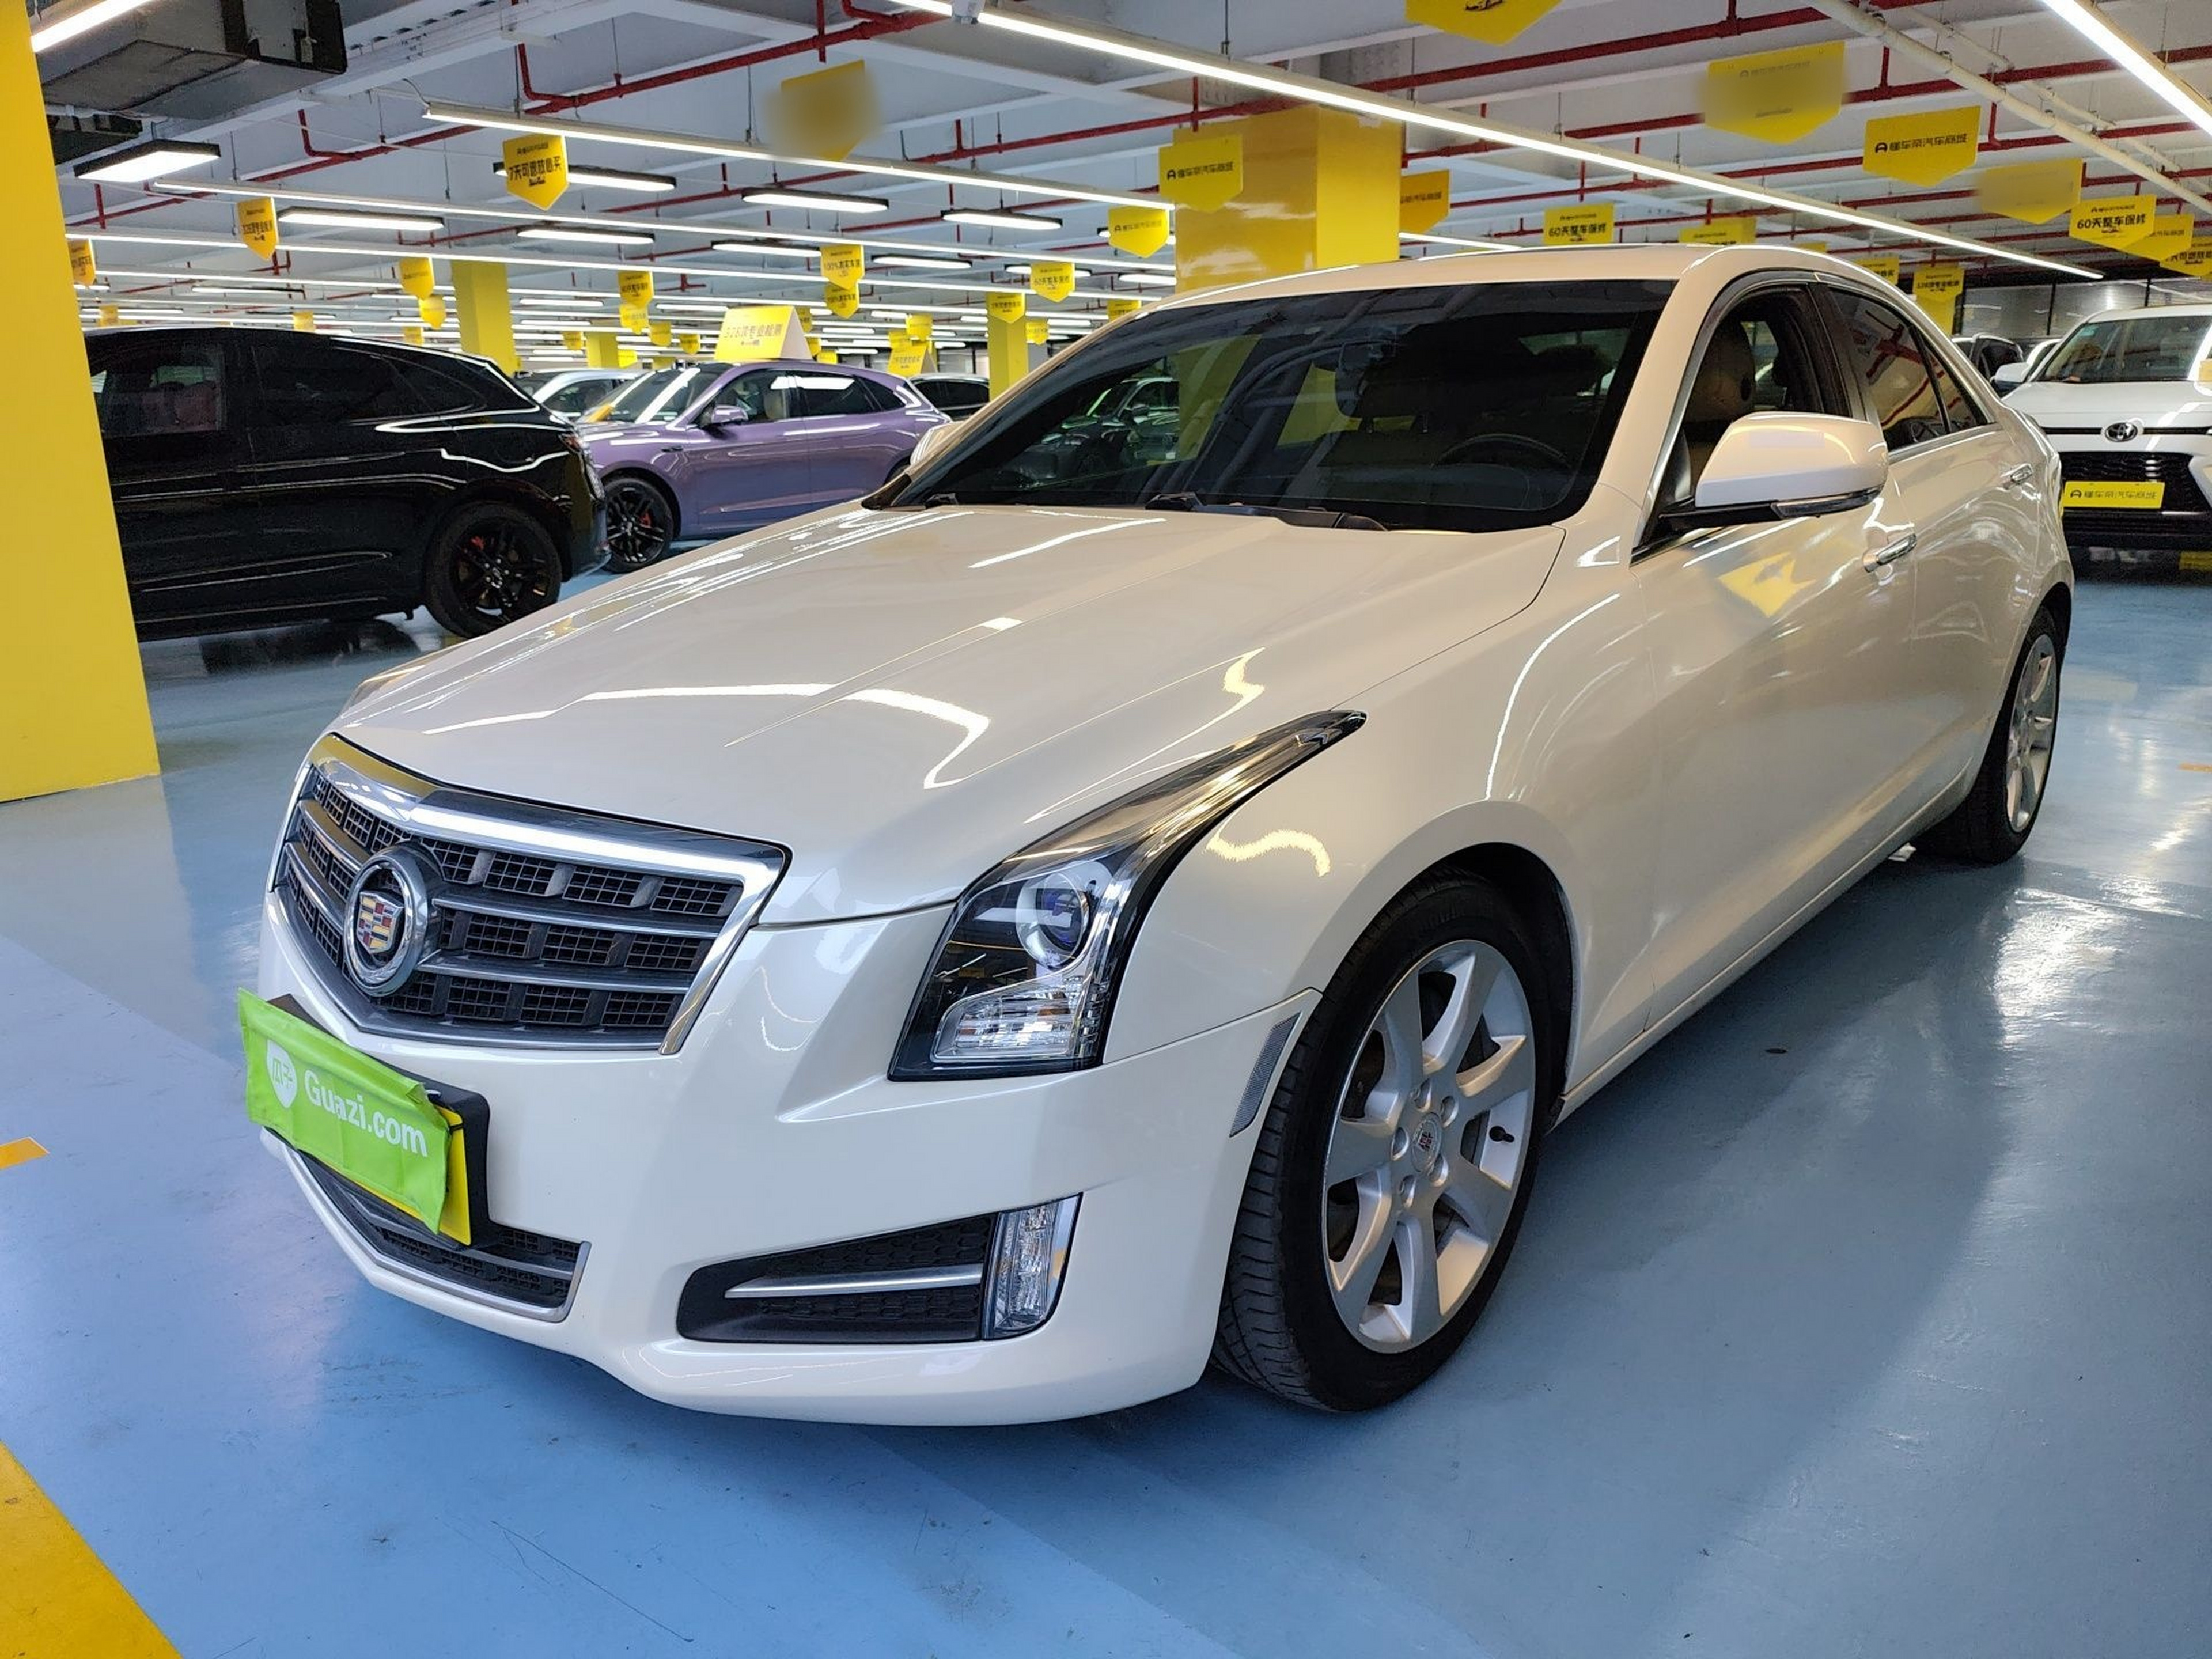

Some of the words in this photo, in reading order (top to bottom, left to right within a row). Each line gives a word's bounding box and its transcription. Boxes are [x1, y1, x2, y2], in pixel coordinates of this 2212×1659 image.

[2077, 214, 2146, 229] 60天整车保修
[305, 1070, 427, 1157] Guazi.com
